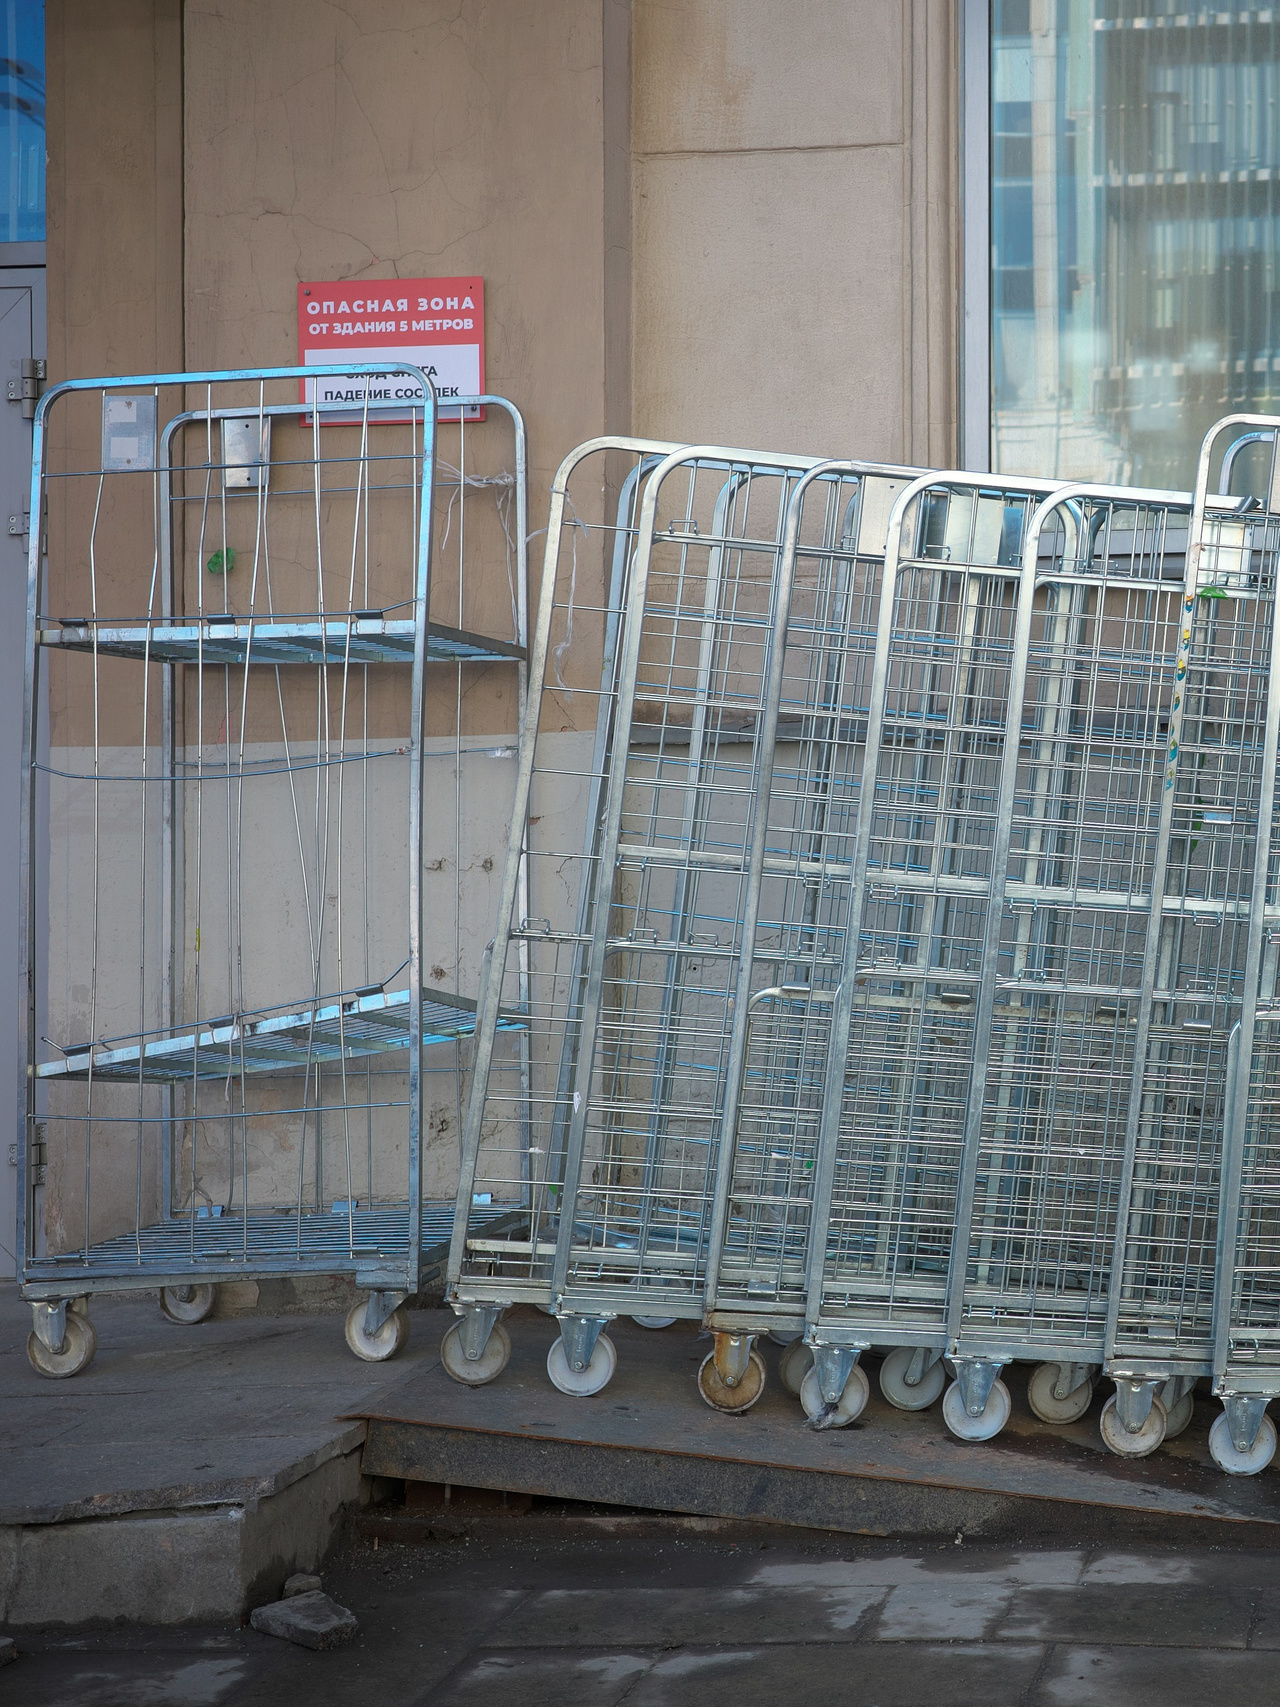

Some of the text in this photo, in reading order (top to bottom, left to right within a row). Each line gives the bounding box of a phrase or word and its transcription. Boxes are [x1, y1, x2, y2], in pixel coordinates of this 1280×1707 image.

[307, 296, 475, 314] ОПАСНАЯ ЗОНА
[308, 318, 474, 336] ОТ ЗДАНИЯ 5 МЕТРОВ
[324, 386, 460, 401] ПАДЕНИЕ СОСЛЕК
